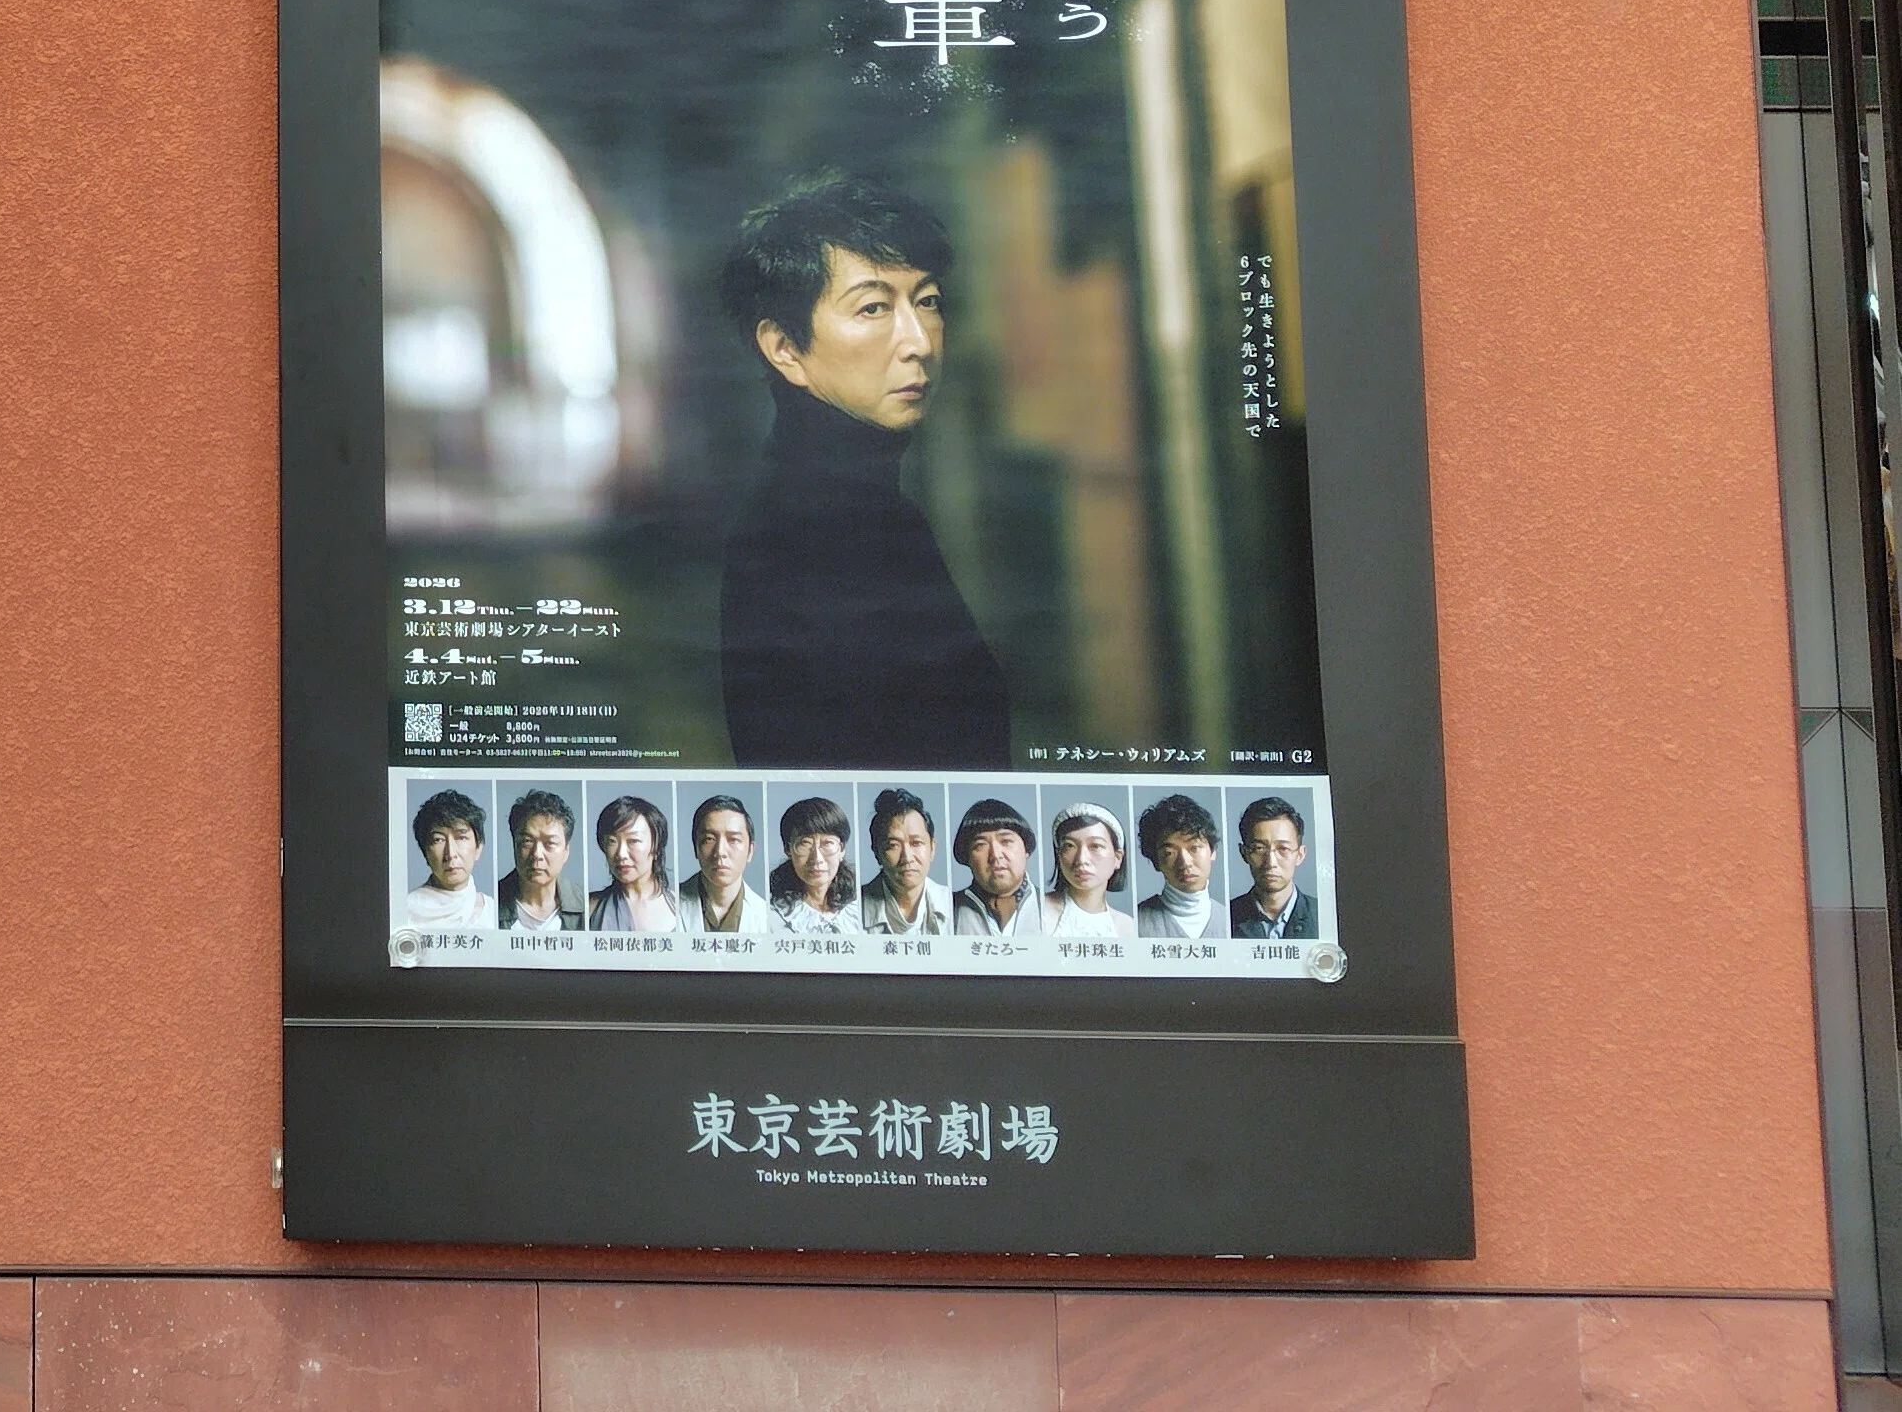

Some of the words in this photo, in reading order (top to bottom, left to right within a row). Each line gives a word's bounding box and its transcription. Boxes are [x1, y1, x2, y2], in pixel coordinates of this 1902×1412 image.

[1238, 254, 1262, 438] 6ブロック先の天国で
[1257, 253, 1281, 429] でも生きようとした
[403, 577, 461, 588] 2026
[404, 669, 497, 686] 近鉄アート館
[1056, 746, 1207, 763] テネシー・ウィリアムズ
[1291, 749, 1313, 764] G2
[593, 936, 673, 953] 松岡依都美
[691, 937, 756, 954] 坂本慶介
[774, 938, 856, 955] 宍戸美和公
[883, 940, 932, 956] 森下創
[970, 941, 1029, 956] ぎたろー
[1058, 942, 1125, 959] 平井珠生
[1150, 943, 1217, 959] 松雪大知
[687, 1092, 1059, 1164] 東京芸術劇場
[755, 1168, 800, 1186] Tokyo
[806, 1169, 917, 1187] Metropolitan
[924, 1172, 988, 1186] Theatre
